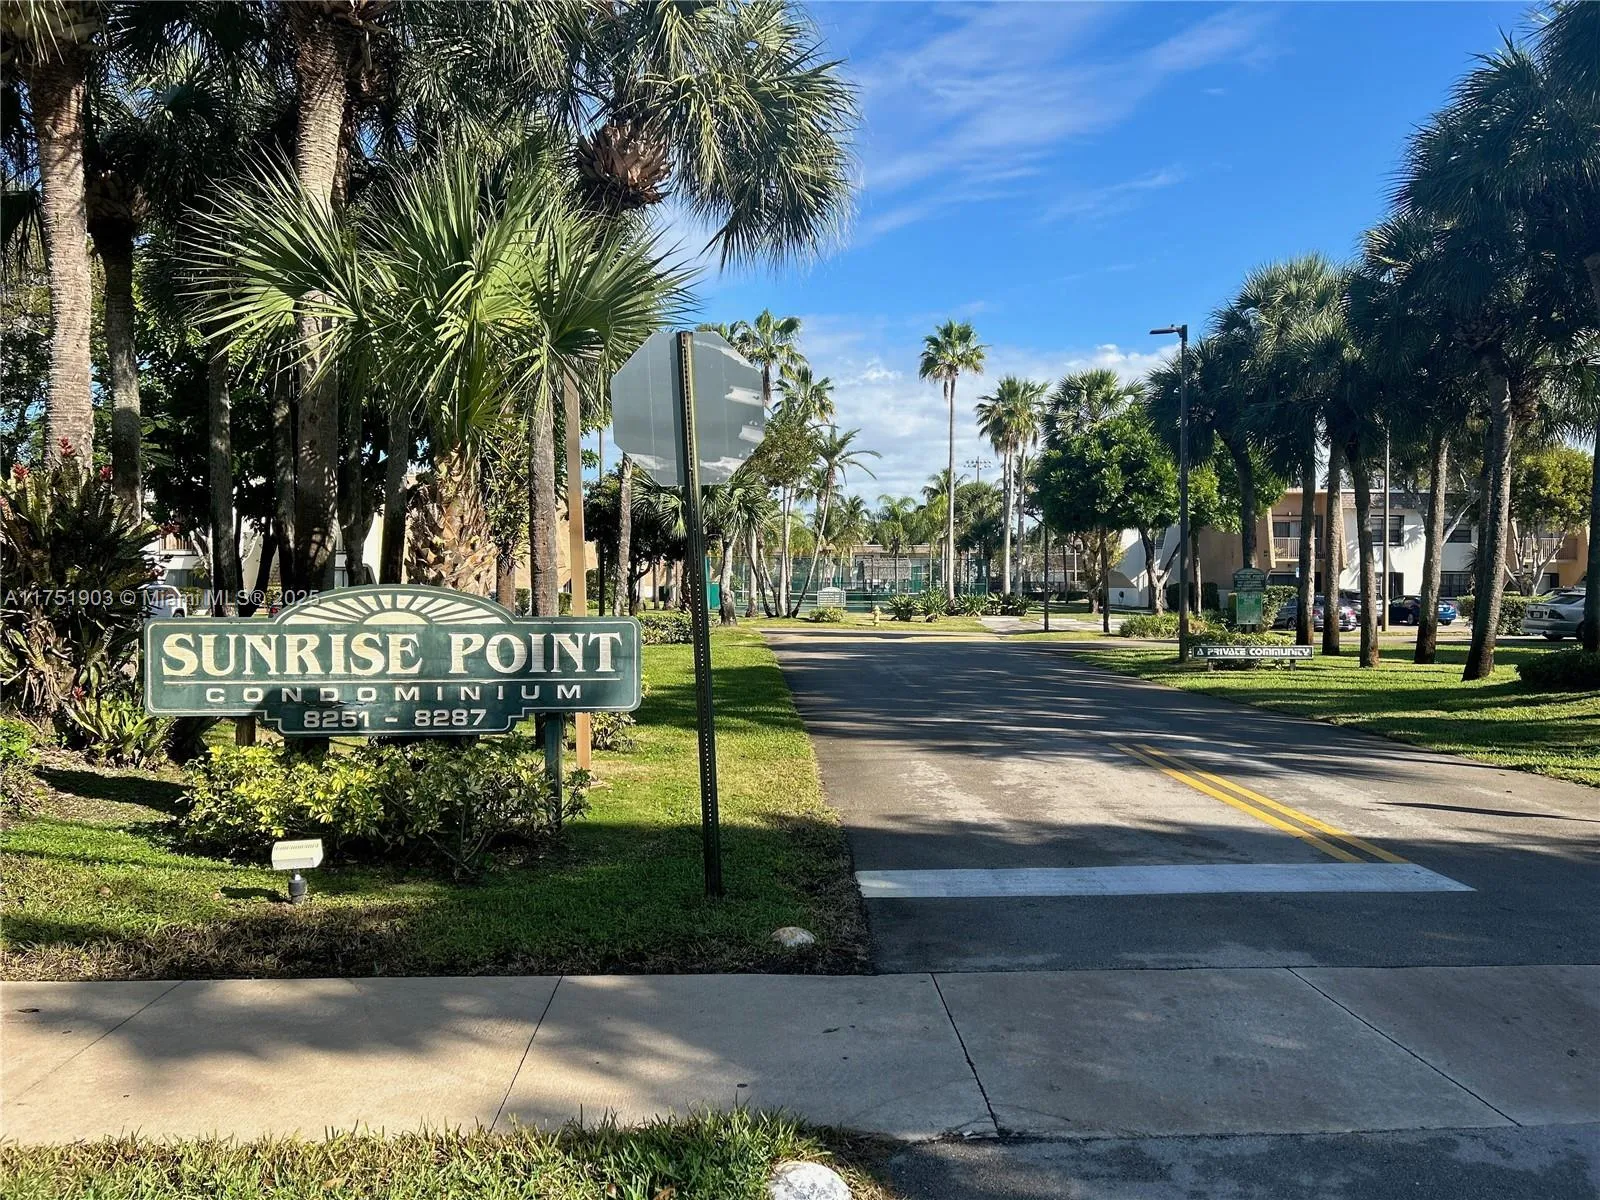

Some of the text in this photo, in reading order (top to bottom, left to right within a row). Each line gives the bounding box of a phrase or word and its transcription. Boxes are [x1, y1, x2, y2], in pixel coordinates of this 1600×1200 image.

[162, 632, 622, 676] SUNRISE POINT
[1207, 648, 1246, 656] PRIVATE
[1249, 648, 1310, 656] COMMUNITY
[205, 684, 581, 703] CONDOMINIUM
[304, 710, 370, 728] 8251
[414, 709, 487, 727] 8287
